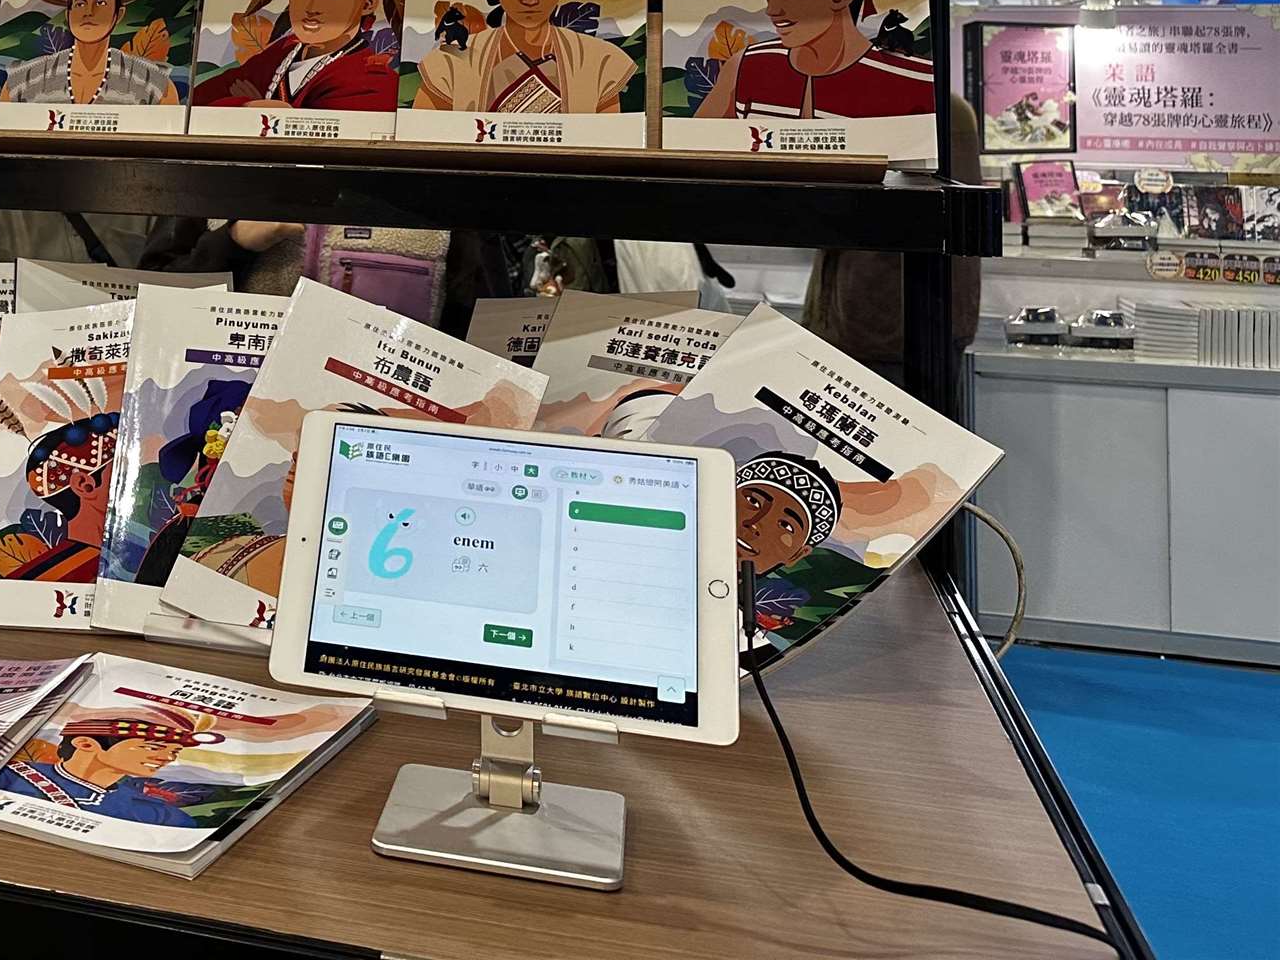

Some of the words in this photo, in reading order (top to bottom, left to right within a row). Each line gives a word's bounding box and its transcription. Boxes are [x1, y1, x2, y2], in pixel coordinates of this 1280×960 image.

[1196, 268, 1219, 281] 420
[1235, 270, 1259, 283] 450
[216, 318, 279, 331] Pinuyuma
[522, 324, 546, 333] Kari
[507, 336, 540, 353] 德固
[617, 326, 644, 338] Kari
[647, 331, 681, 346] sediq
[686, 338, 717, 351] Toda
[377, 340, 396, 355] Itu
[400, 349, 441, 374] Bunun
[373, 355, 433, 393] 布農語
[352, 370, 440, 415] 中高級應考指南
[823, 383, 877, 422] Kebalan
[799, 389, 879, 448] 噶瑪蘭語
[782, 405, 866, 465] 中高級應考指南
[453, 534, 495, 551] enem
[490, 629, 516, 641] 下一個
